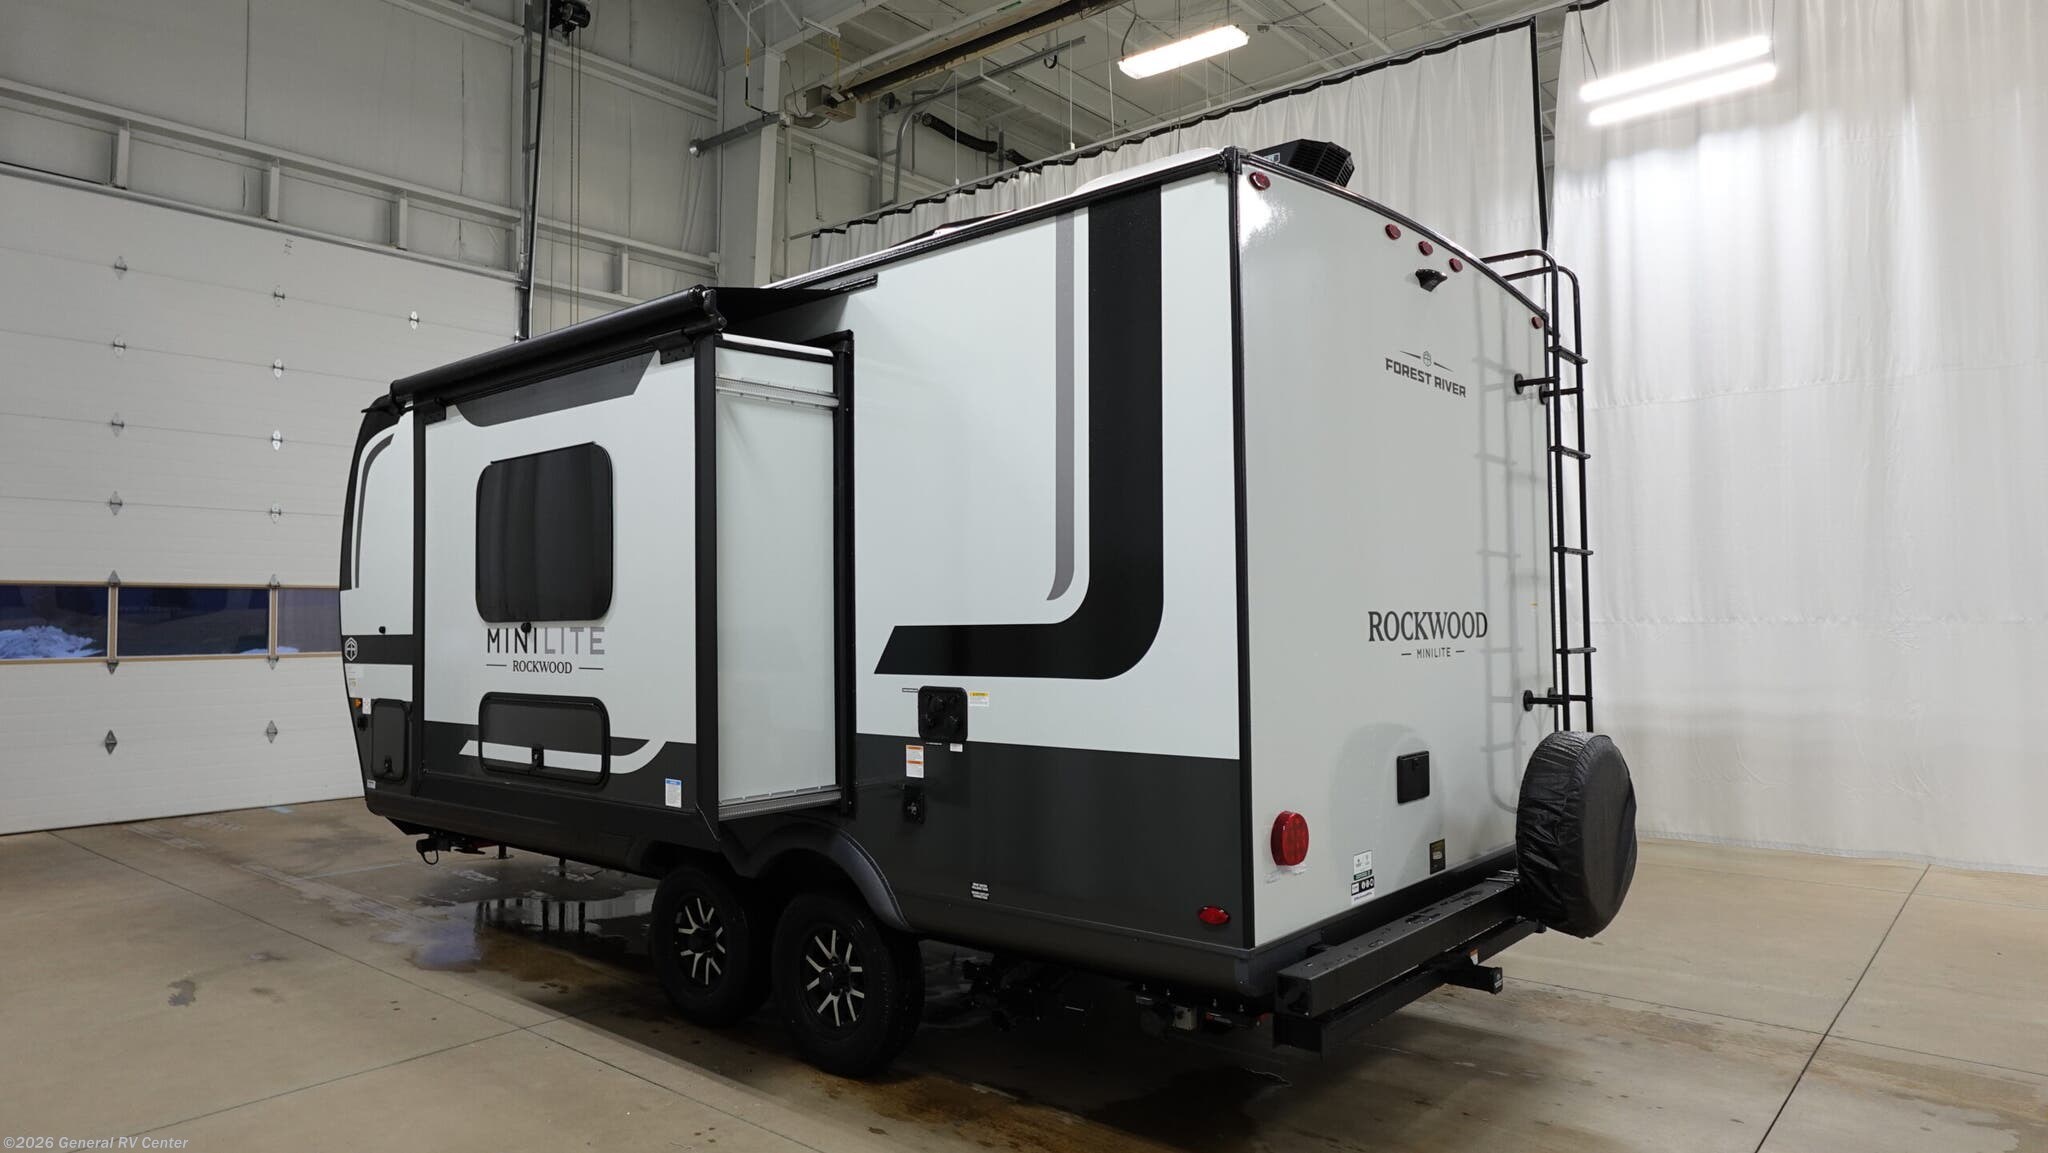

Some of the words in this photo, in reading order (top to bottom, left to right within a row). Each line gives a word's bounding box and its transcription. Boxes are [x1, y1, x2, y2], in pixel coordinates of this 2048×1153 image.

[1385, 358, 1432, 385] FOREST
[1434, 375, 1466, 398] RIVER
[1368, 611, 1488, 641] ROCKWOOD
[487, 627, 605, 655] MINILITE
[1416, 647, 1451, 659] MINILITE
[512, 660, 573, 674] ROCKWOOD
